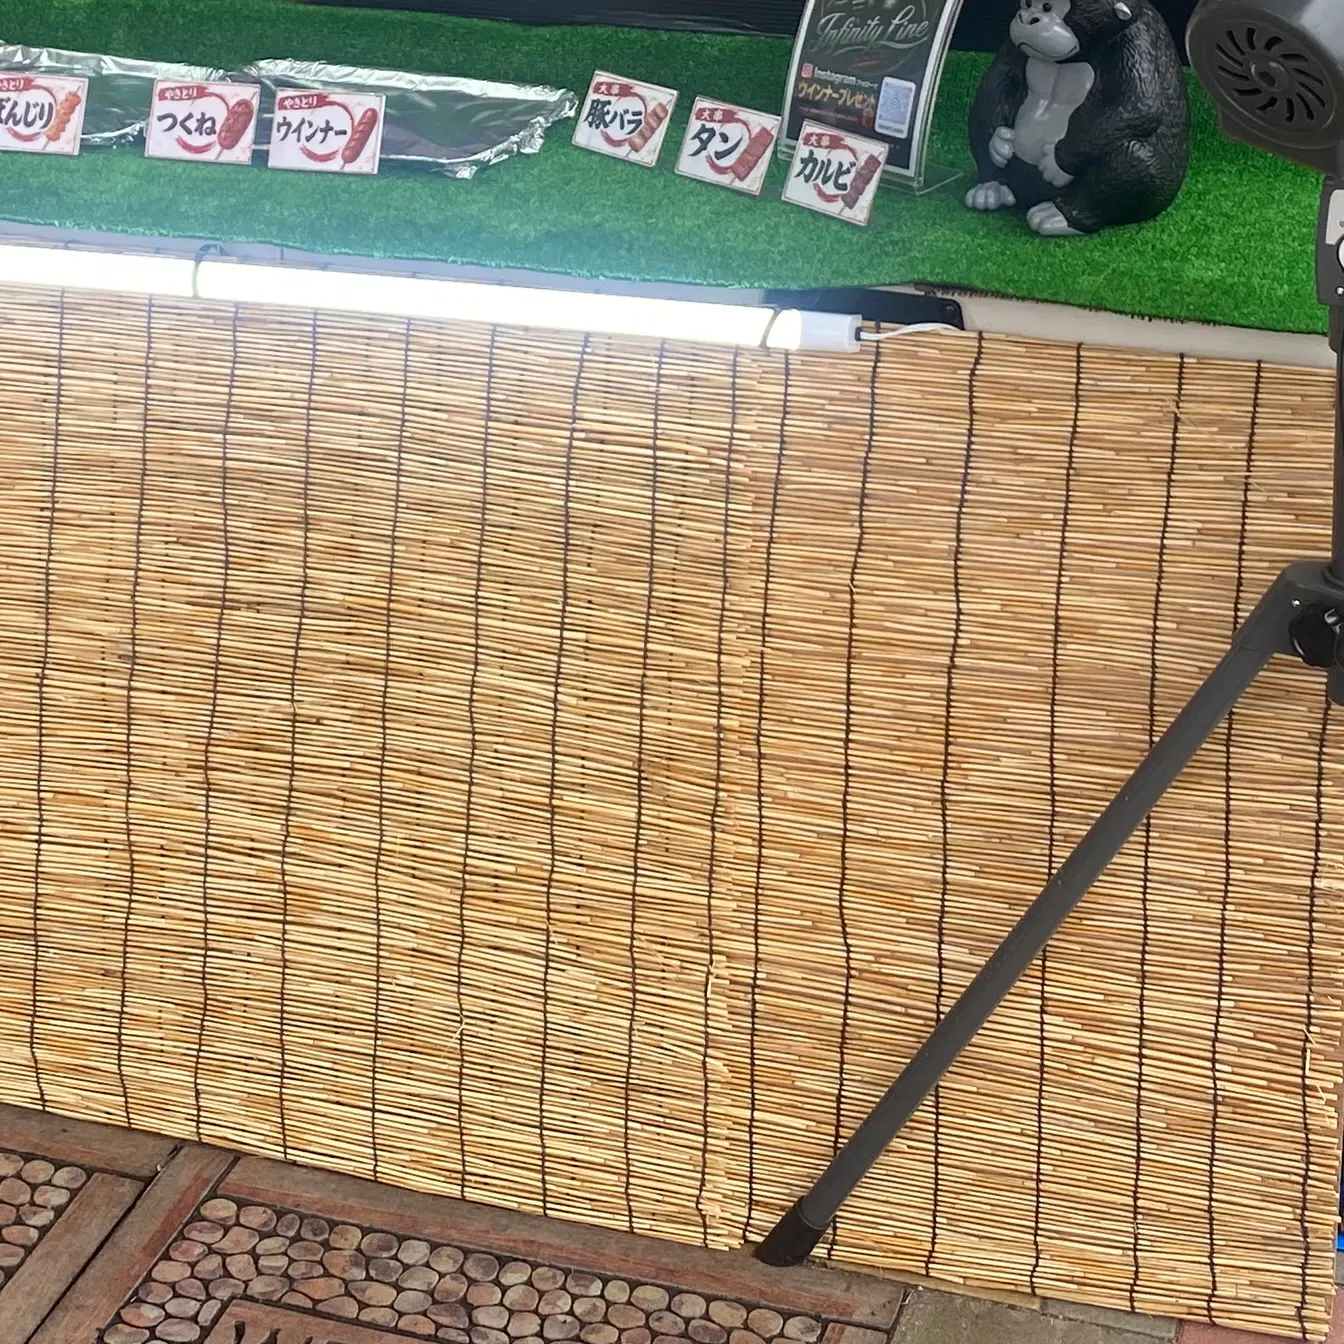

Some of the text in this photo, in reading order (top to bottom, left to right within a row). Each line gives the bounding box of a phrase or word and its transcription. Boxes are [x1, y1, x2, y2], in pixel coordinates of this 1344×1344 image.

[814, 4, 930, 49] Infinity Line
[598, 82, 622, 97] 大串
[156, 109, 218, 138] つくね
[583, 98, 645, 136] 豚バラ
[699, 108, 725, 123] 大串
[687, 122, 745, 162] タン
[807, 132, 831, 149] 大串
[796, 149, 859, 193] カルビ
